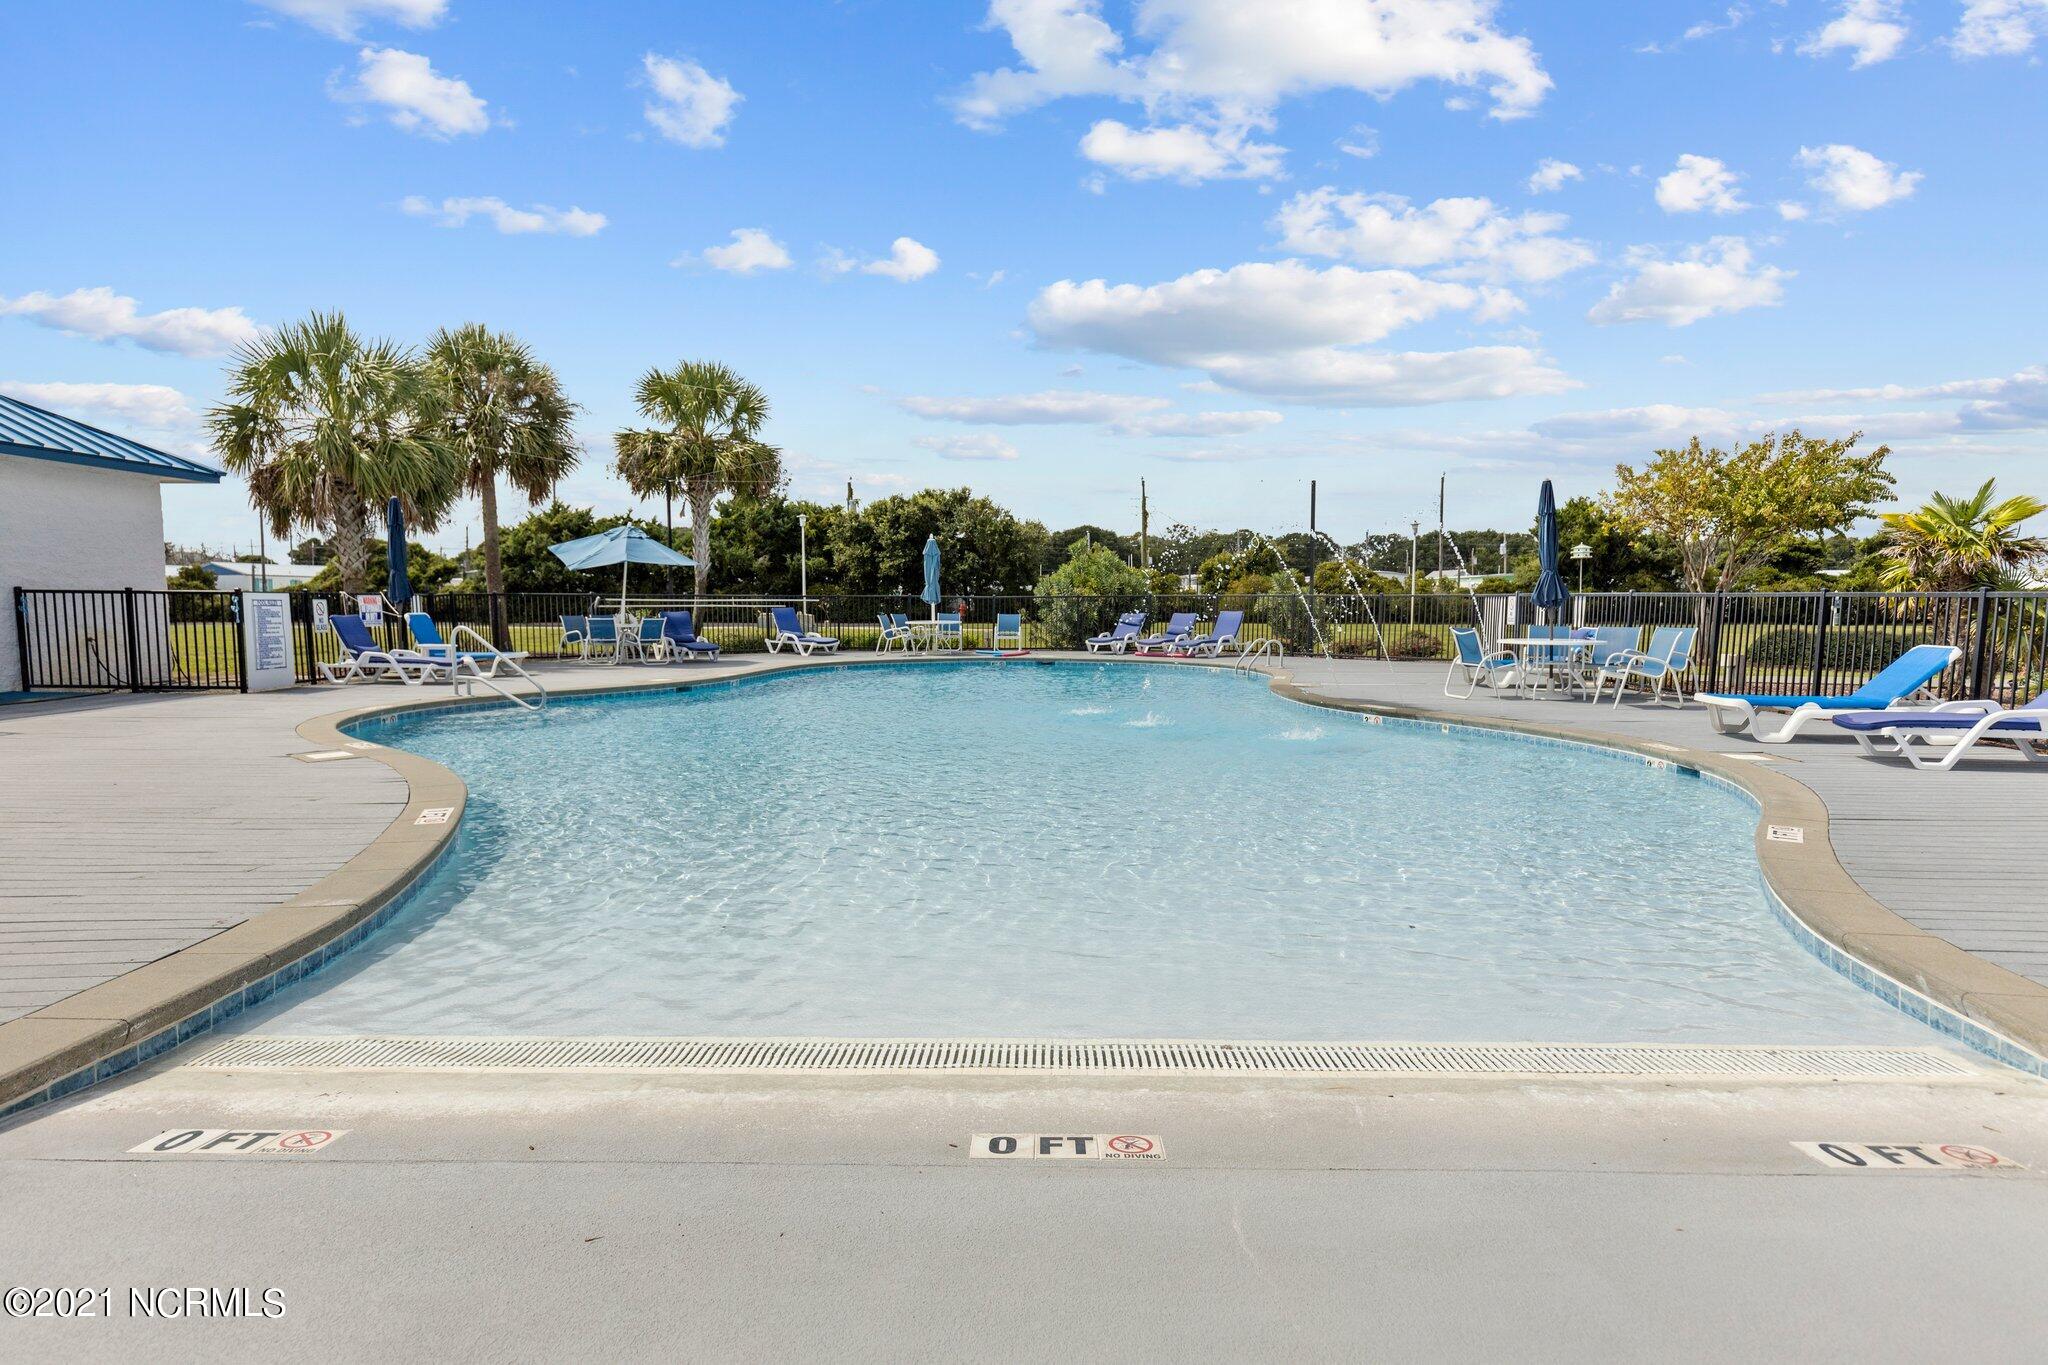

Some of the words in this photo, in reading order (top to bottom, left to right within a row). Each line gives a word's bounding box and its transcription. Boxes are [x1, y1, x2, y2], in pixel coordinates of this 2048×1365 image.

[153, 1129, 205, 1151] 0
[200, 1131, 282, 1150] FT
[988, 1136, 1018, 1155] 0
[1039, 1136, 1094, 1155] FT
[1817, 1143, 1868, 1167] 0
[1864, 1145, 1942, 1165] FT
